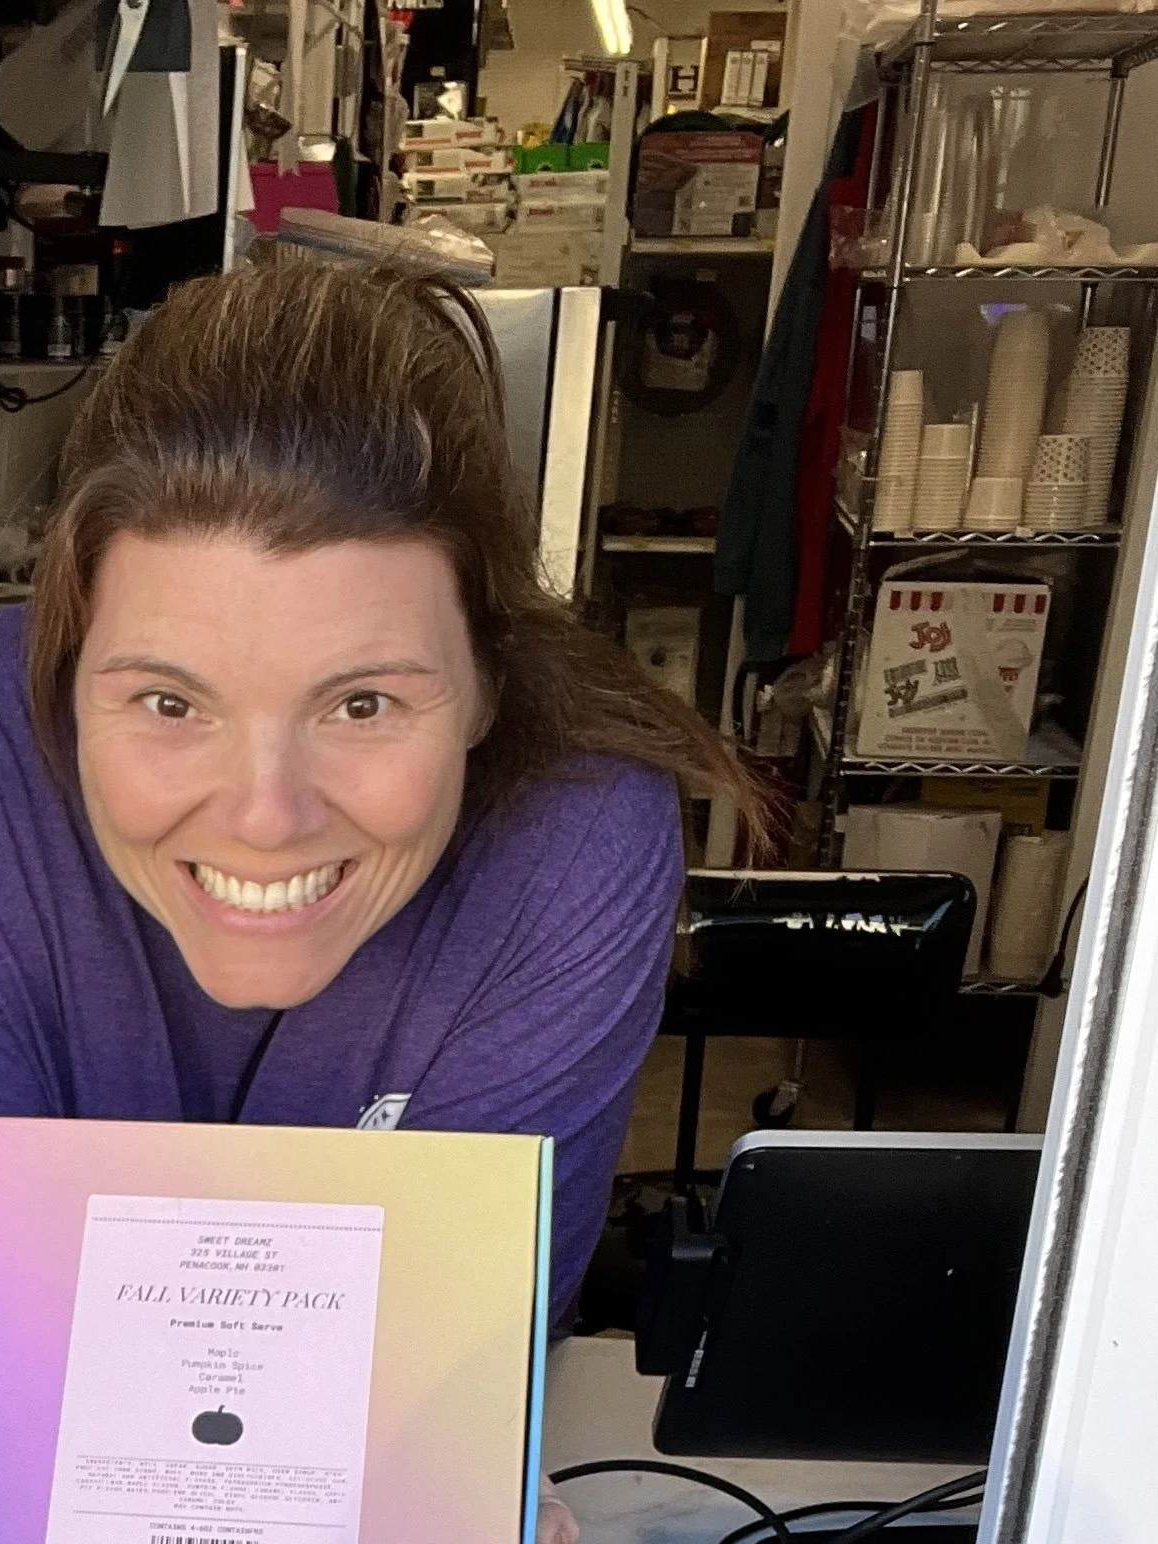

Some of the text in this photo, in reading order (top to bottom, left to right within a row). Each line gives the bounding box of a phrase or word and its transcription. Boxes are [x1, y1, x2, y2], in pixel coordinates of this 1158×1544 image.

[197, 1235, 273, 1247] SWEET DREAMZ
[215, 1249, 259, 1259] VILLAGE
[264, 1251, 278, 1260] ST
[116, 1283, 345, 1311] FALL VARIETY PACK
[170, 1319, 283, 1332] Premium Soft Serve
[207, 1348, 240, 1359] Maple
[181, 1359, 264, 1371] Pumpkin Spice
[198, 1372, 243, 1383] Caramel
[188, 1384, 246, 1396] Apple Pie
